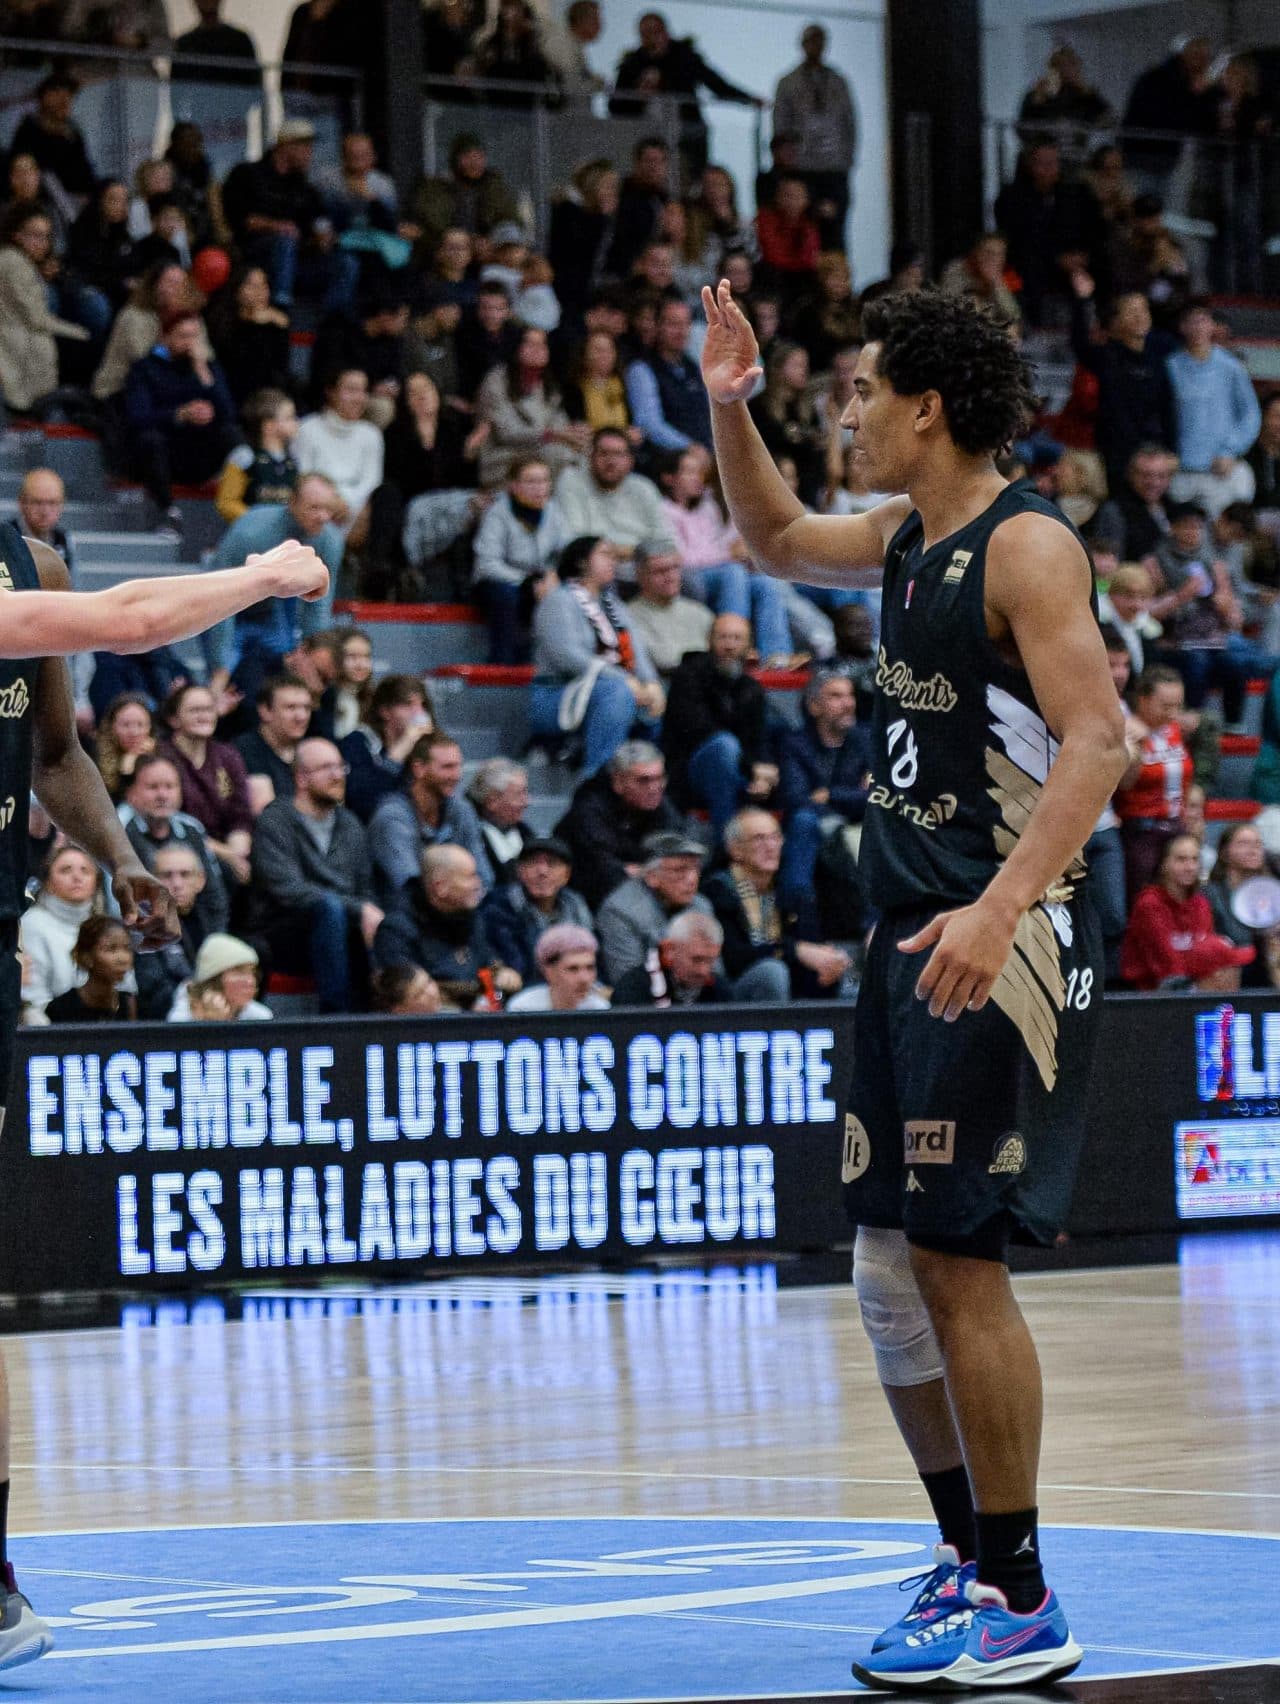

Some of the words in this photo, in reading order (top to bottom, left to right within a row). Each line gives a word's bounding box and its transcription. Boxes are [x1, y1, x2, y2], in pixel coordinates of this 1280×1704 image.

[1066, 967, 1094, 1010] 18
[28, 1046, 354, 1156] ENSEMBLE,
[366, 1034, 616, 1141] LUTTONS
[627, 1028, 836, 1130] CONTRE
[117, 1169, 226, 1275] LES
[239, 1155, 521, 1268] MALADIES
[533, 1152, 608, 1250] DU
[621, 1143, 776, 1246] CŒUR
